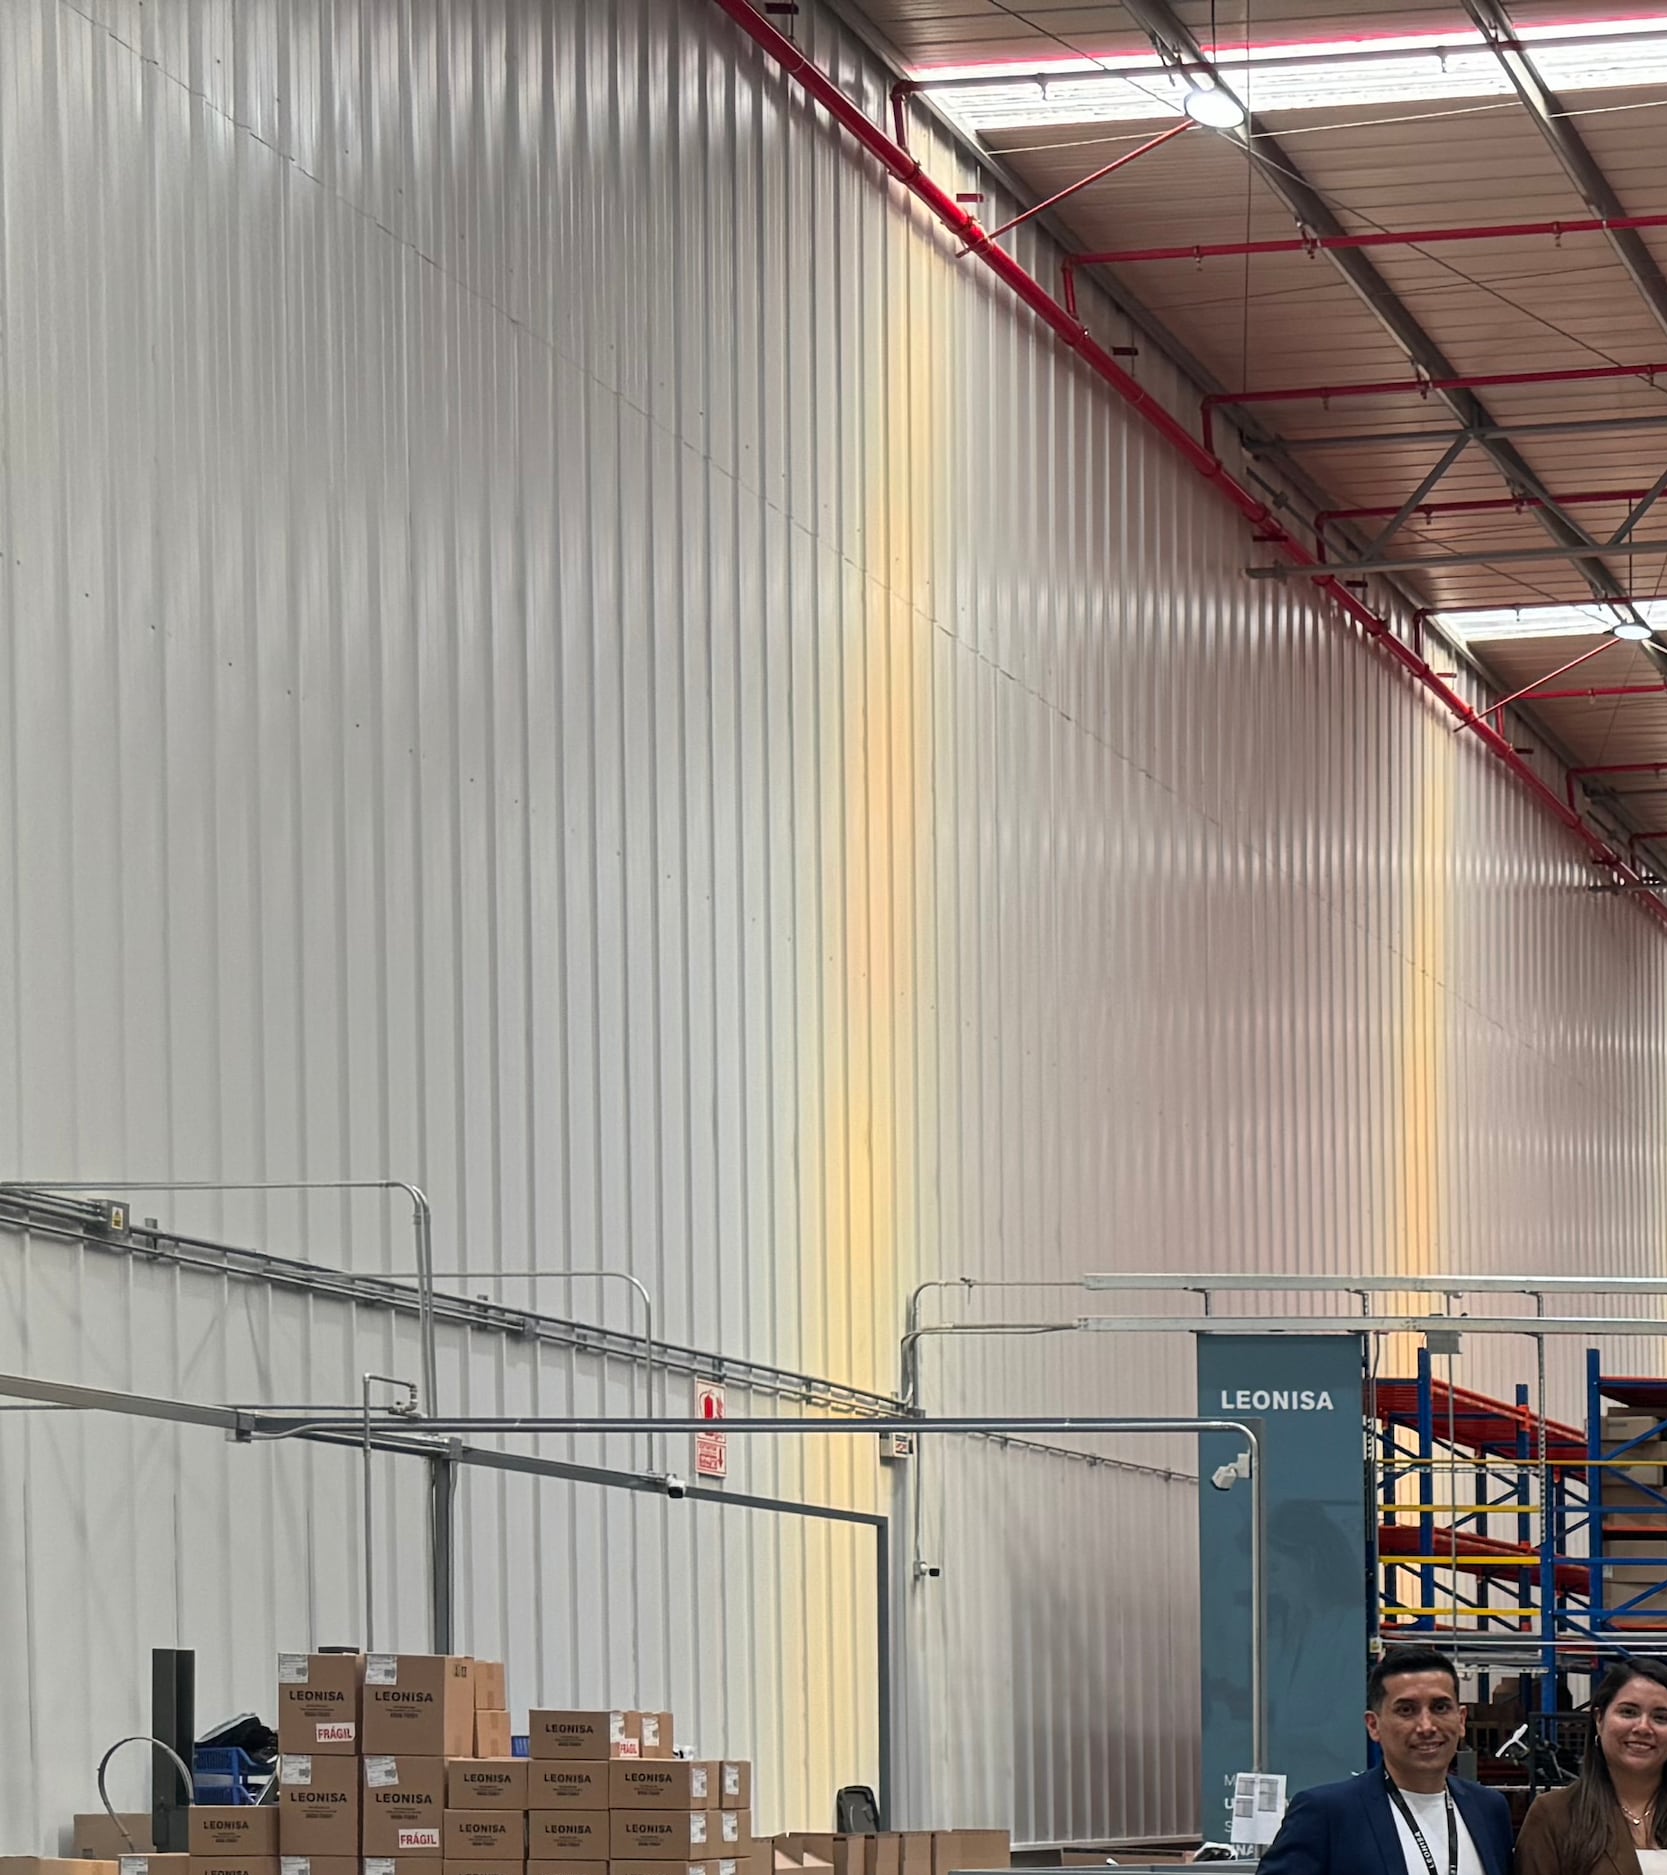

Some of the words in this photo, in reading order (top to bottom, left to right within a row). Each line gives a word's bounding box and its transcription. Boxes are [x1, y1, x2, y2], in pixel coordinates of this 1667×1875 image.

[1221, 1390, 1334, 1410] LEONISA
[289, 1690, 345, 1702] LEONISA
[374, 1691, 434, 1703] LEONISA
[317, 1725, 353, 1740] FRÁGIL
[545, 1723, 594, 1734] LEONISA
[463, 1773, 512, 1784] LEONISA
[543, 1773, 592, 1784] LEONISA
[624, 1772, 673, 1783] LEONISA
[290, 1792, 348, 1803] LEONISA
[375, 1793, 433, 1805] LEONISA
[203, 1820, 249, 1830] LEONISA
[459, 1823, 507, 1834] LEONISA
[544, 1824, 592, 1834] LEONISA
[625, 1823, 673, 1834] LEONISA
[400, 1830, 437, 1846] FRÁGIL
